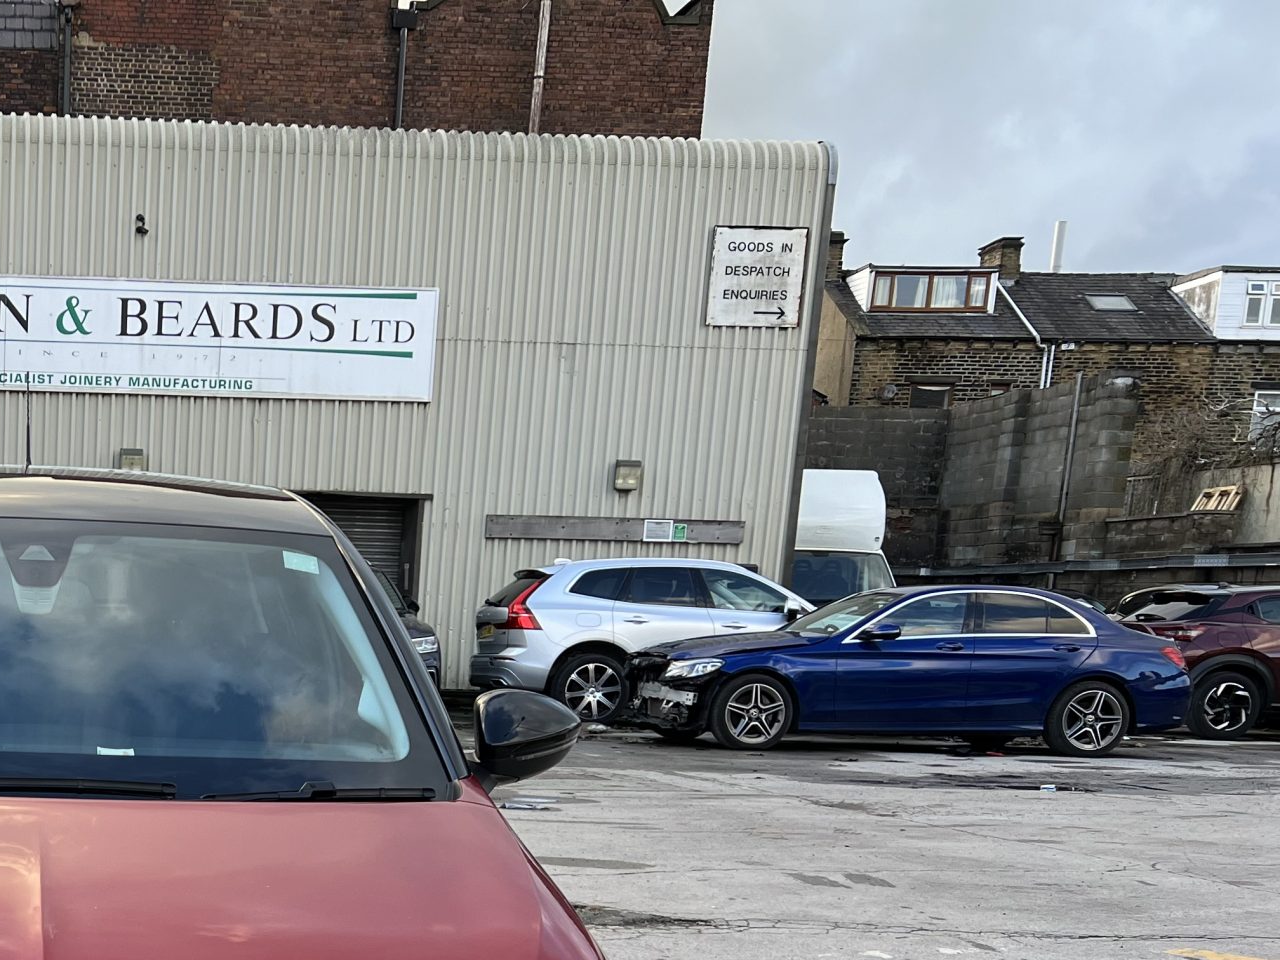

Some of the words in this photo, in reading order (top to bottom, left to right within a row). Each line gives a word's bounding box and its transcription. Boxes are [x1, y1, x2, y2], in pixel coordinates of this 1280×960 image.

[728, 241, 774, 253] GOODS
[781, 242, 793, 253] IN
[724, 265, 791, 277] DESPATCH
[722, 289, 788, 301] ENQUIRIES
[56, 295, 92, 336] &
[116, 297, 337, 343] BEARDS
[350, 319, 415, 343] LTD
[60, 374, 122, 387] JOINERY
[128, 376, 253, 390] MANUFACTURING
